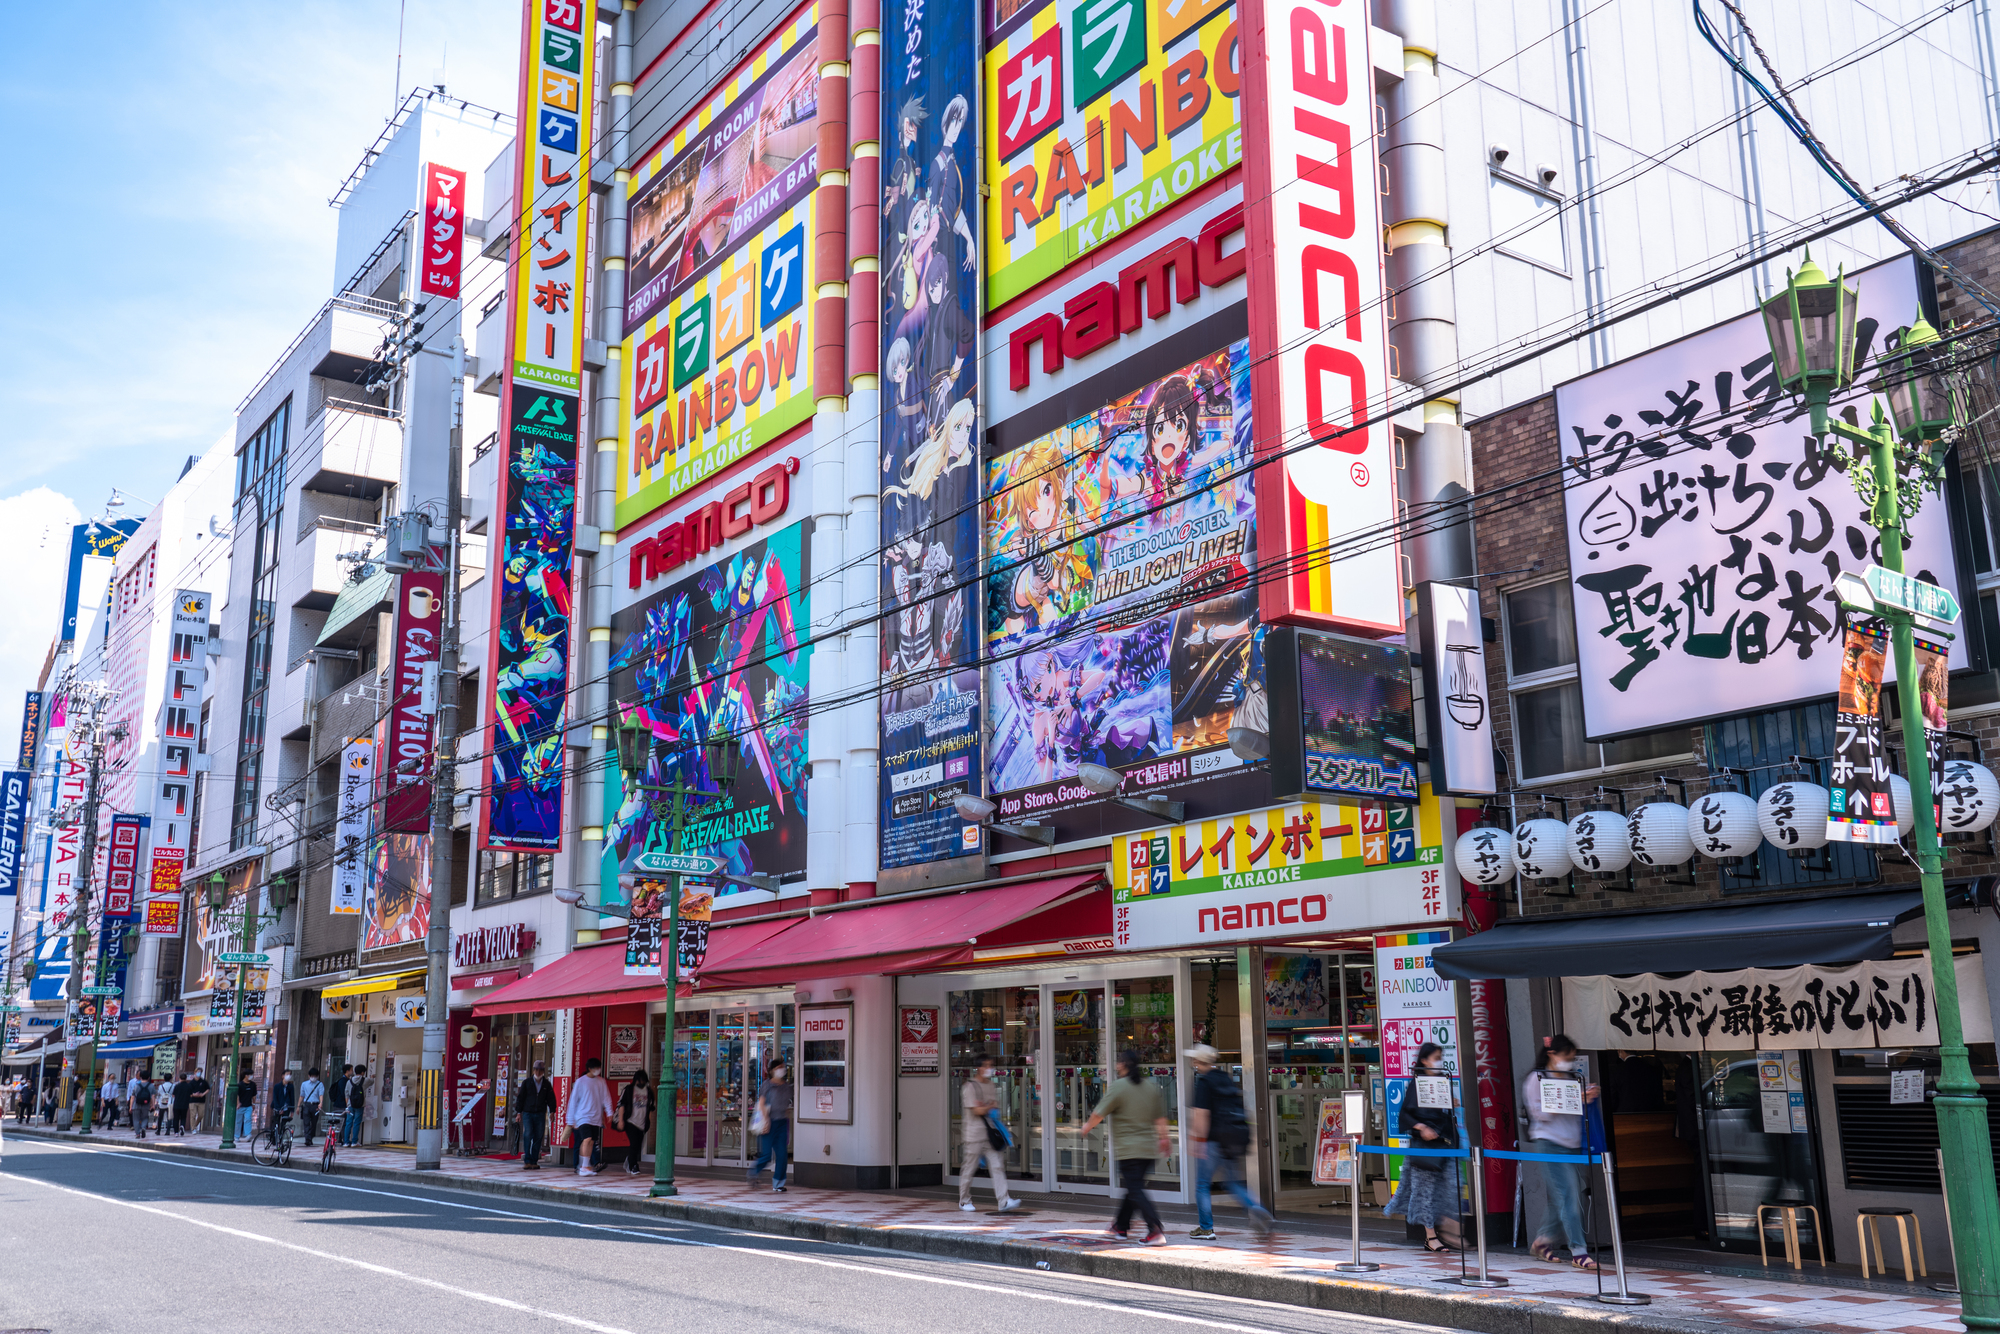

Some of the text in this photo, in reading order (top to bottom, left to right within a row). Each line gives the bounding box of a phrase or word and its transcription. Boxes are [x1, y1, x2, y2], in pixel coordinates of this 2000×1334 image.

[544, 0, 577, 143] カラオケ
[713, 102, 754, 151] ROOM
[733, 156, 817, 234] DRINK BAR
[1078, 128, 1242, 254] KARAOKE
[431, 172, 458, 265] マルタン
[1290, 0, 1369, 455] amco
[533, 154, 573, 358] レインボー
[429, 272, 453, 287] ビル
[628, 274, 668, 321] FRONT
[639, 244, 799, 403] カラオケ
[519, 366, 576, 385] KARAOKE
[634, 319, 801, 476] RAINBOW
[670, 427, 752, 495] KARAOKE
[628, 463, 789, 589] namco
[1095, 520, 1247, 605] MILLION LIVE!
[1110, 546, 1134, 568] THE
[885, 711, 916, 736] TALES
[916, 707, 928, 722] OF
[930, 700, 946, 718] THE
[948, 691, 976, 713] RAYS
[24, 702, 39, 757] ネットカフェ
[1836, 726, 1880, 756] フード
[949, 761, 964, 775] 検索
[1194, 755, 1221, 769] ミリシタ
[1832, 755, 1890, 784] ホール
[1308, 756, 1417, 795] スタジオルーム
[55, 761, 86, 864] ATHNA
[1000, 793, 1020, 814] App
[1769, 785, 1799, 845] あさり
[0, 778, 23, 888] GALLERIA
[670, 815, 734, 852] RSENAL
[734, 805, 770, 838] BASE
[1701, 796, 1732, 852] しじみ
[1133, 840, 1166, 864] カラ
[1179, 811, 1352, 874] レインボー
[1366, 833, 1411, 861] オケ
[1516, 824, 1543, 875] しじみ
[1575, 814, 1600, 869] あさり
[651, 856, 708, 870] なんさん通り
[1420, 848, 1438, 863] 4F
[1473, 831, 1502, 883] オヤジ
[154, 868, 181, 876] ディング
[1134, 869, 1168, 892] オケ
[1223, 866, 1301, 889] KARAOKE
[1421, 870, 1439, 884] 3F
[1116, 890, 1129, 901] 4F
[1422, 885, 1440, 900] 2F
[1117, 907, 1129, 918] 3F
[1198, 894, 1327, 933] namco
[1423, 902, 1441, 915] 1F
[629, 923, 660, 937] フード
[678, 926, 708, 939] フード
[1118, 920, 1130, 932] 2F
[485, 923, 520, 961] VELOCE
[628, 937, 662, 951] ホール
[678, 940, 708, 953] ホール
[1064, 939, 1113, 954] namco
[1118, 933, 1130, 944] 1F
[1396, 956, 1434, 970] カラオケ
[213, 992, 233, 1000] フード
[245, 992, 264, 1000] フード
[1383, 977, 1450, 994] RAINBOW
[212, 999, 234, 1008] ホール
[244, 999, 264, 1008] ホール
[1610, 973, 1926, 1038] くそオヤジ最後のひとふり
[805, 1019, 844, 1032] namco
[1414, 1027, 1449, 1045] 0 0
